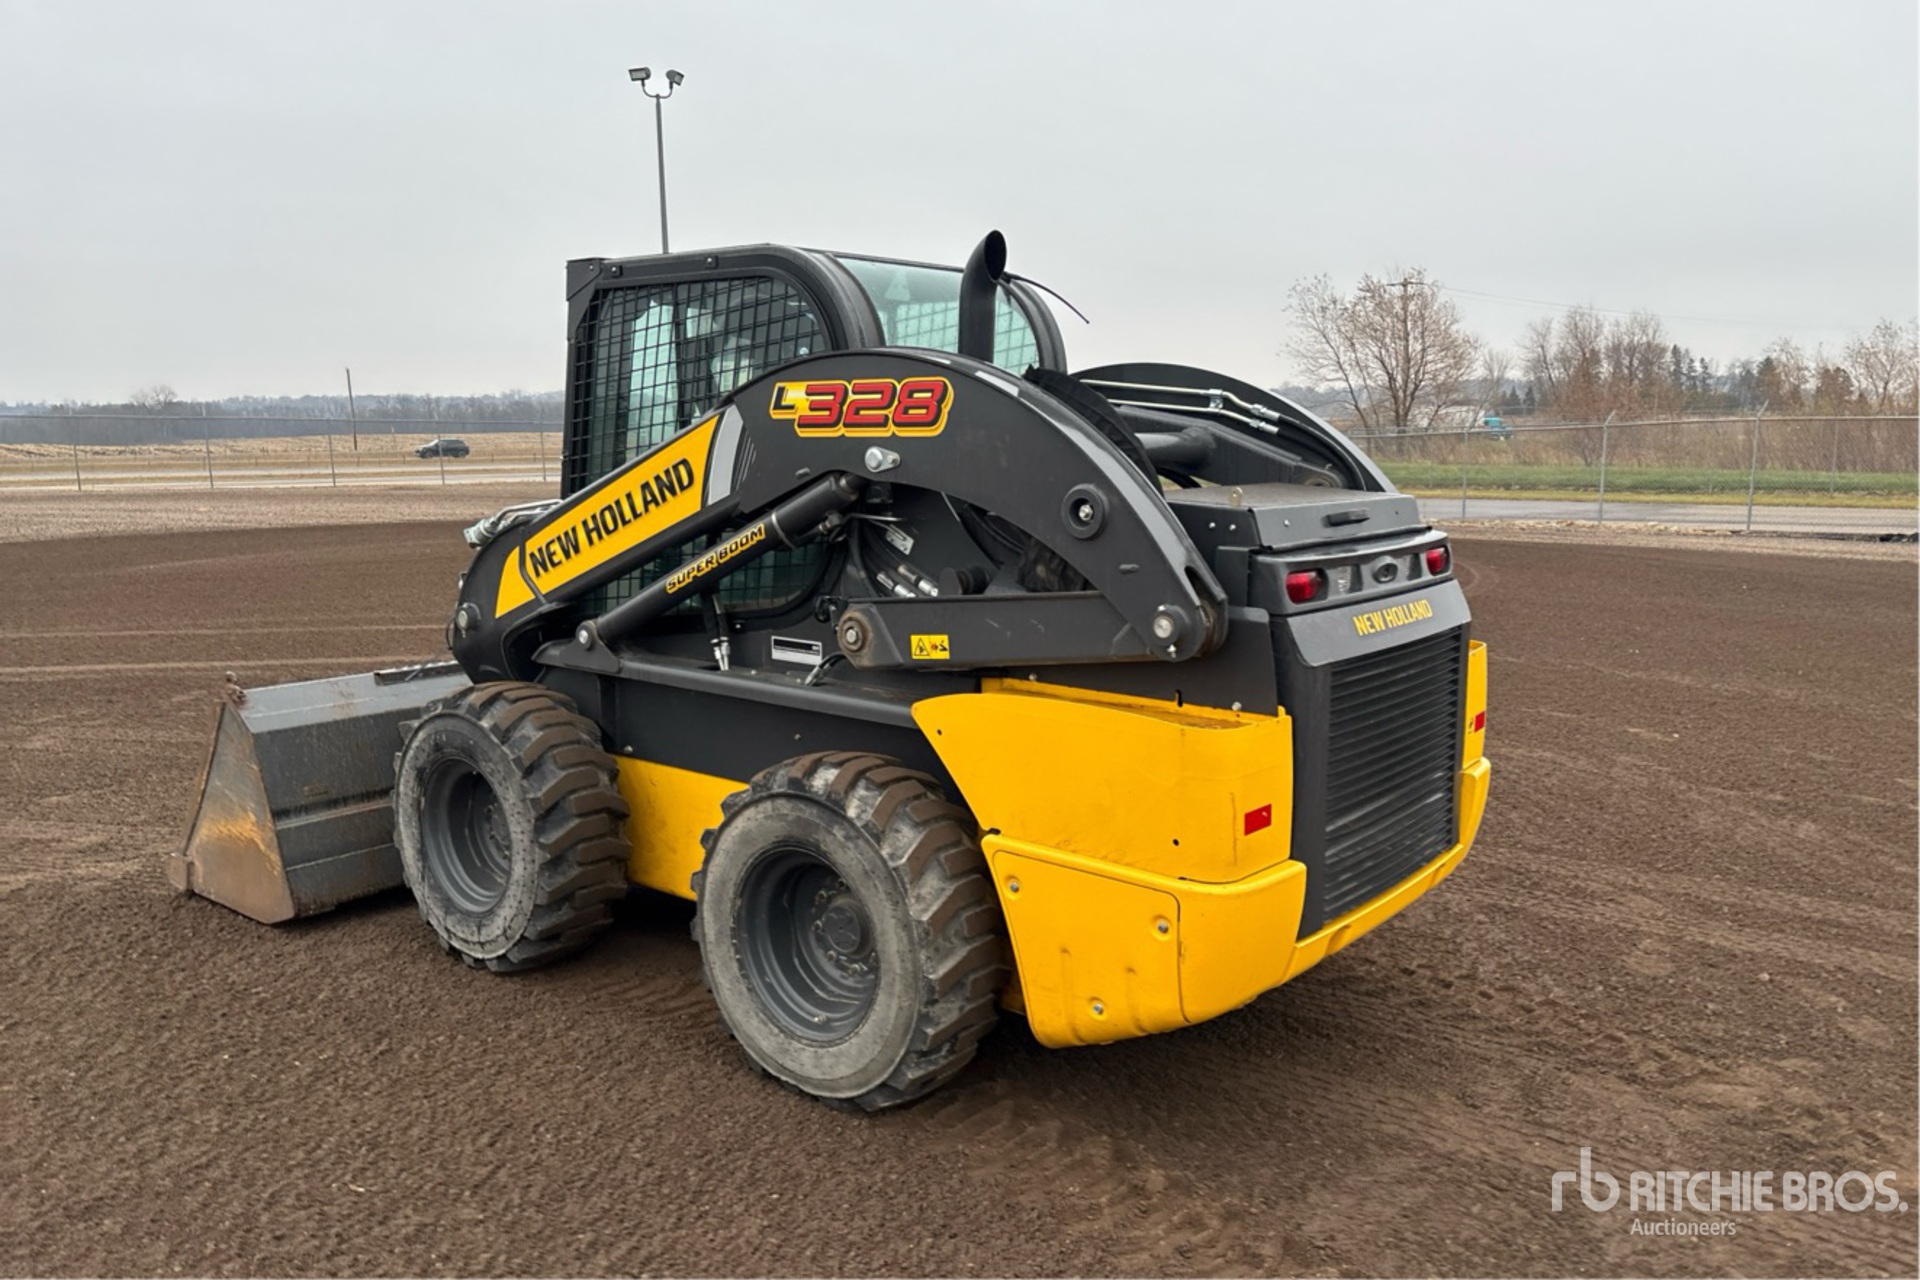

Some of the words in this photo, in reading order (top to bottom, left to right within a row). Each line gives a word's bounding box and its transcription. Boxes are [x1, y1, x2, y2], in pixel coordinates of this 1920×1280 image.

[529, 525, 581, 579] NEW
[584, 457, 695, 547] HOLLAND
[666, 552, 717, 594] SUPER
[717, 524, 766, 564] BOOM
[1353, 610, 1385, 636] NEW
[1382, 599, 1433, 629] HOLLAND
